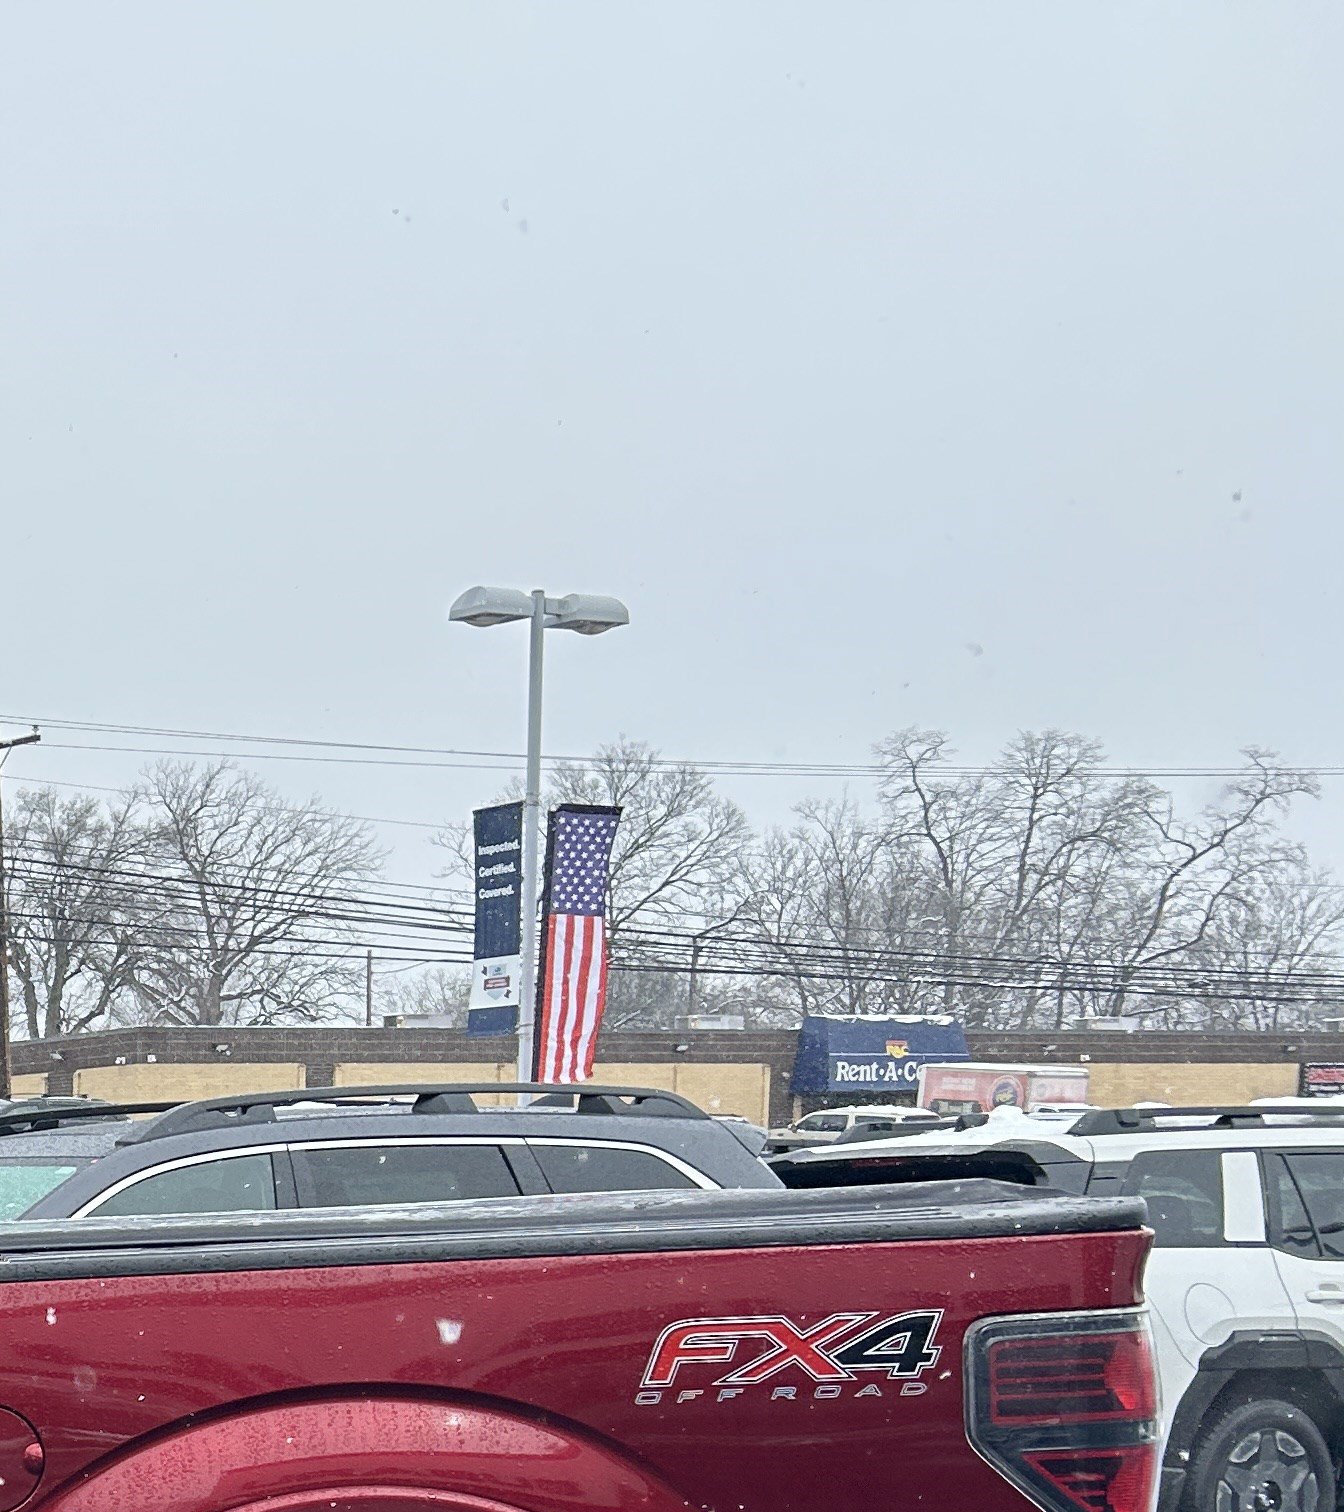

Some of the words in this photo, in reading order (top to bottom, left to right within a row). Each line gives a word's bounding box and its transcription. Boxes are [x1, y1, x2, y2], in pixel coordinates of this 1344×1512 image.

[639, 1308, 945, 1388] FX4
[635, 1388, 745, 1405] OFF
[771, 1382, 928, 1400] ROAD
